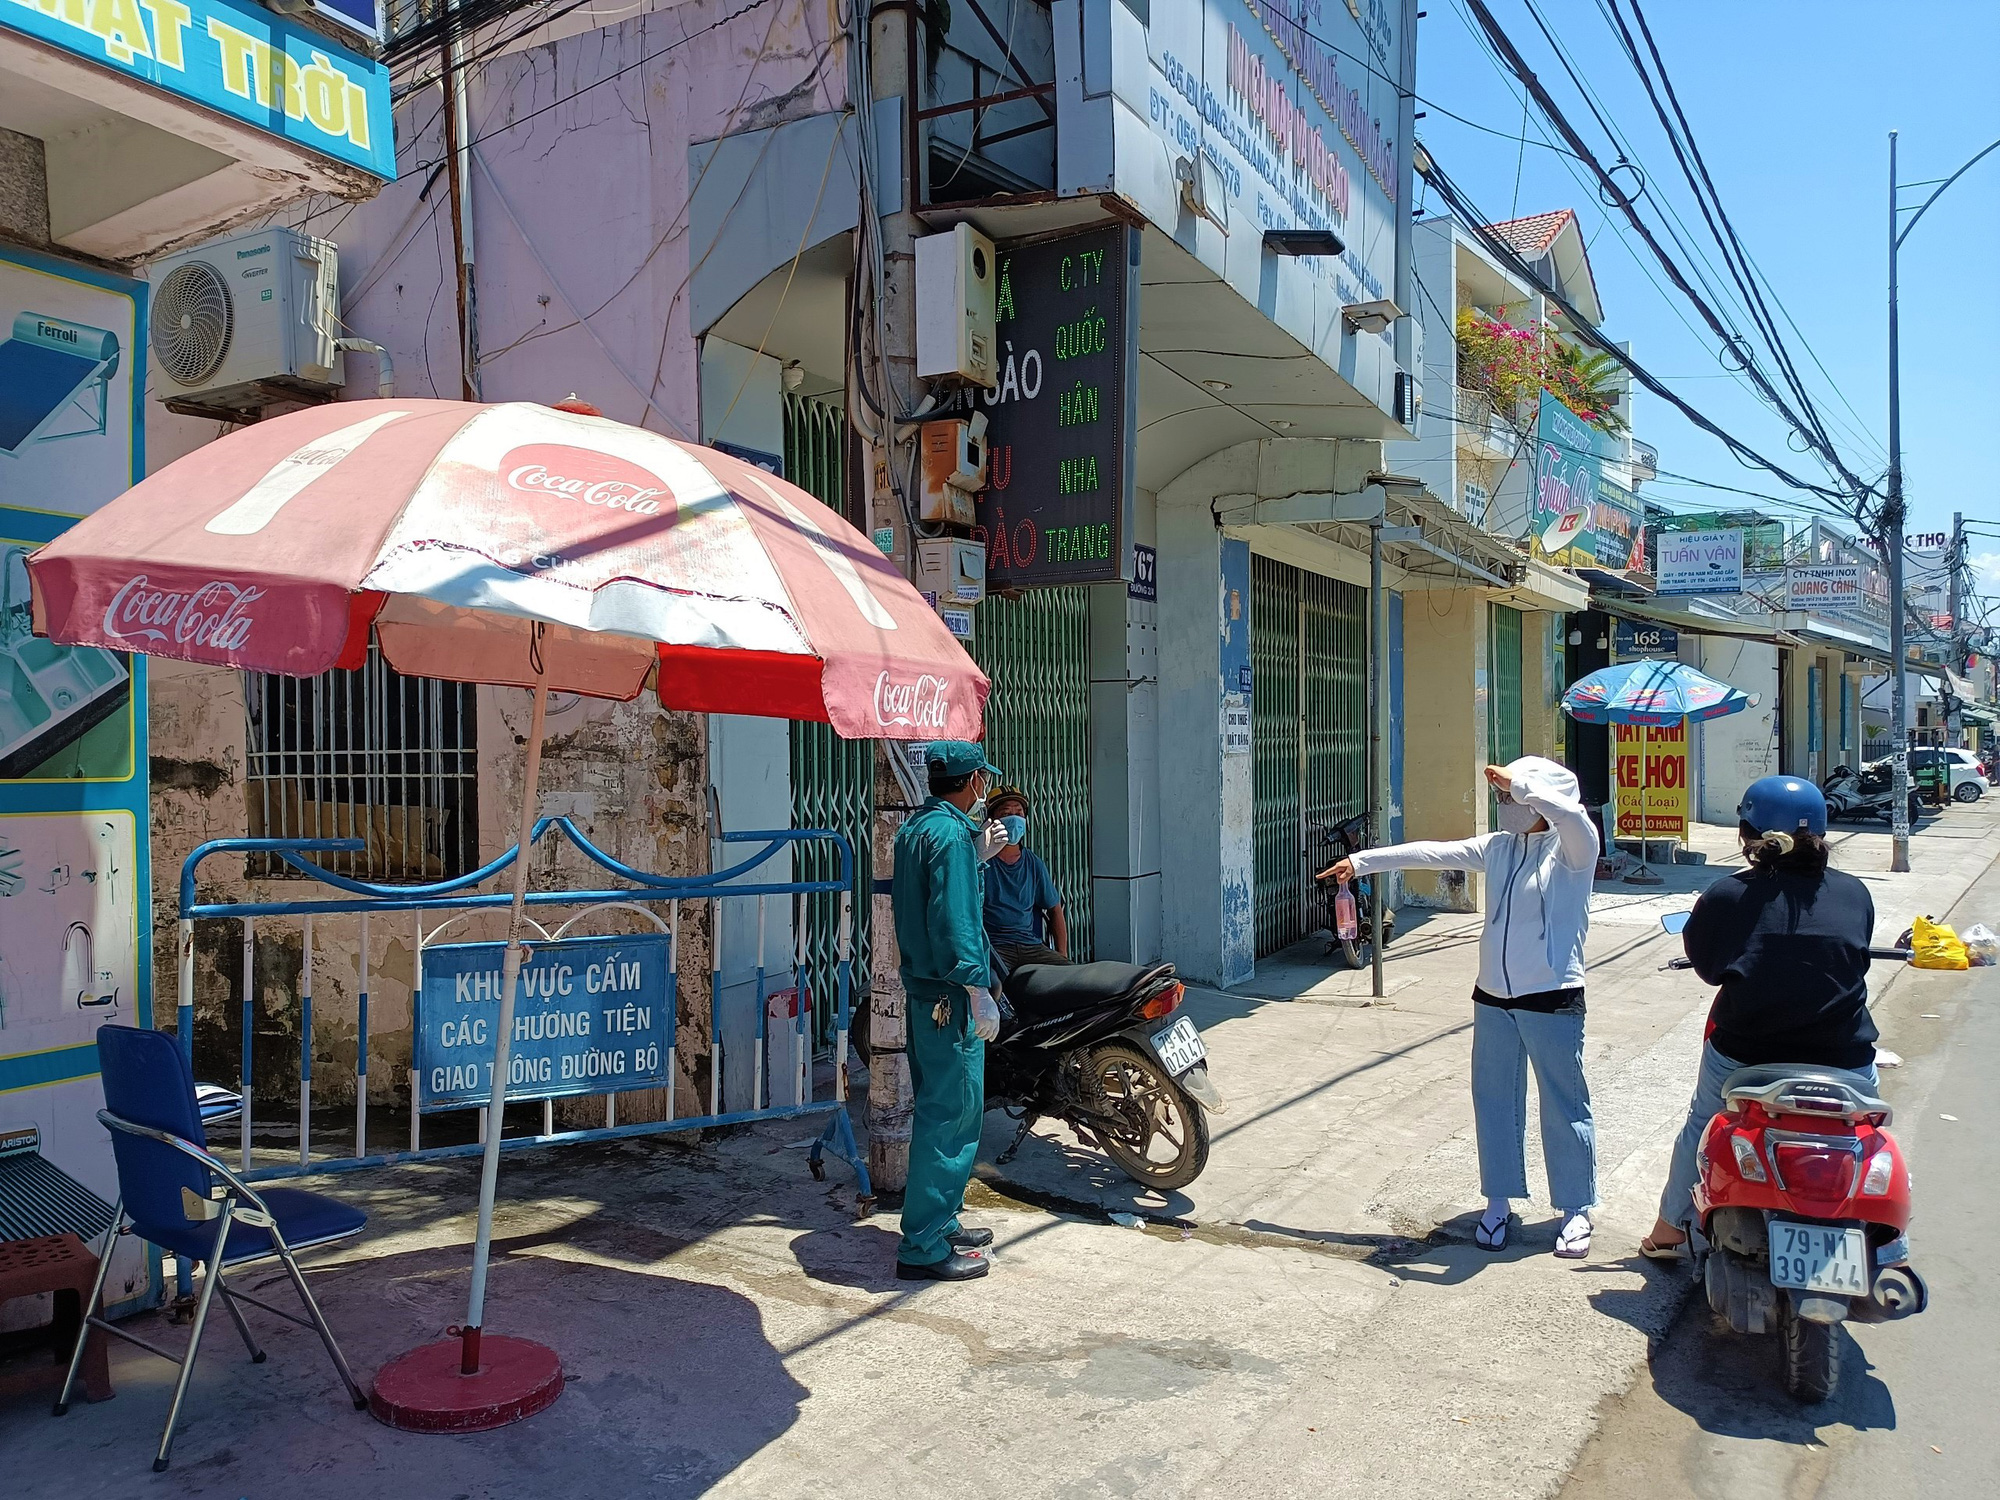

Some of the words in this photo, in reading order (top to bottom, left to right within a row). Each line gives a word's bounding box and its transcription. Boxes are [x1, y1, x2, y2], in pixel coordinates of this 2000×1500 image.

[207, 16, 371, 151] TRỜI
[236, 244, 271, 259] Panasonic
[241, 267, 269, 279] INVERTER
[37, 321, 78, 343] Ferroli
[1055, 306, 1106, 361] QUỐC
[1060, 380, 1098, 427] HÂN
[507, 464, 667, 516] Coca-Cola
[1060, 456, 1099, 494] NHA
[1045, 522, 1110, 563] TRANG
[1661, 545, 1700, 563] TUẤN
[1704, 545, 1736, 561] VÂN
[1679, 535, 1700, 543] HIỆU
[1702, 534, 1725, 542] GIÀY
[1791, 579, 1829, 596] QUANG
[1792, 569, 1808, 579] CTY
[1810, 569, 1834, 578] TNHH
[1835, 567, 1857, 577] INOX
[103, 574, 268, 651] Coca-Cola
[1628, 643, 1665, 653] shophouse
[1633, 630, 1661, 645] 168
[873, 669, 950, 728] Coca-Cola
[1617, 755, 1639, 788] XE
[1646, 754, 1685, 789] HƠI
[1647, 795, 1679, 810] Loại)
[1621, 817, 1634, 829] CÓ
[1655, 816, 1681, 830] HÀNH
[456, 970, 502, 1003] KHU
[522, 962, 573, 1003] VỰC
[586, 951, 641, 994] CẤM
[441, 1014, 487, 1048] CÁC
[511, 1009, 591, 1042] HƯƠNG
[603, 1002, 651, 1036] TIỆN
[1032, 1011, 1075, 1031] TAURUS
[1157, 1022, 1191, 1054] 79-N1
[431, 1063, 478, 1093] GIAO
[561, 1048, 625, 1080] ĐƯỜNG
[635, 1042, 659, 1076] BỘ
[1164, 1037, 1204, 1074] 020.47
[1, 1134, 37, 1150] ARISTON
[1784, 1226, 1848, 1261] 79-N1
[1776, 1255, 1861, 1288] 394.44
